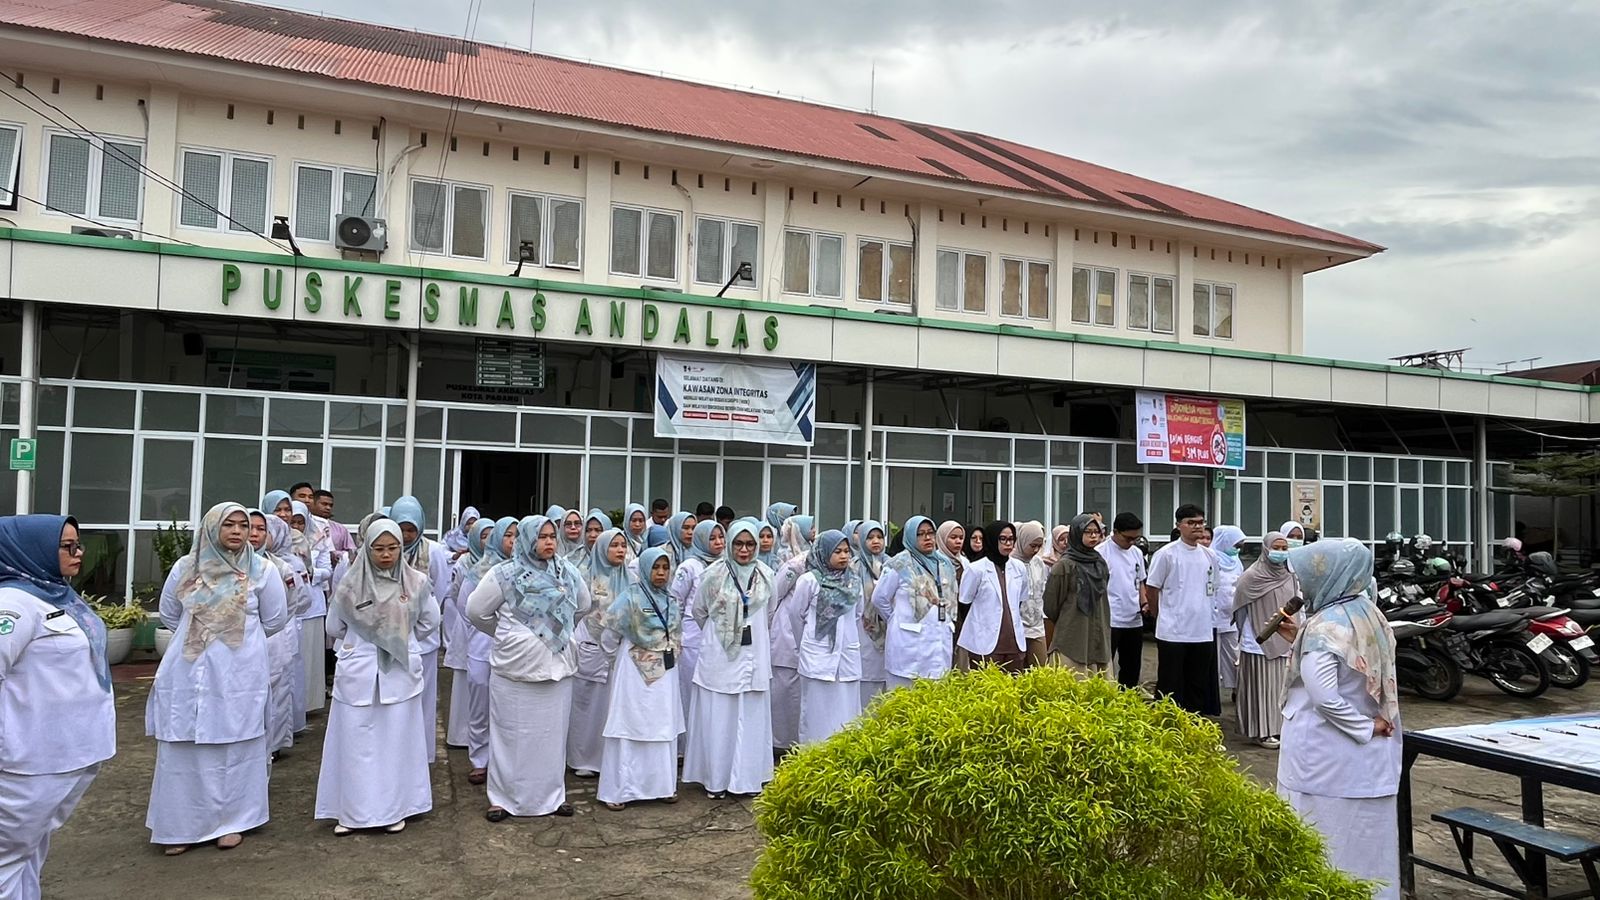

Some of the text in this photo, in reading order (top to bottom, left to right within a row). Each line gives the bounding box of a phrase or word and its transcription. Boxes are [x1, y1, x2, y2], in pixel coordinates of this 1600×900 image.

[222, 264, 780, 352] PUSKESMAS ANDALAS
[485, 394, 519, 402] PADANG
[683, 384, 768, 399] KAWASAN ZONA INTEGRITAS
[16, 442, 31, 459] P
[1197, 449, 1209, 461] PLUS
[1216, 470, 1223, 482] P
